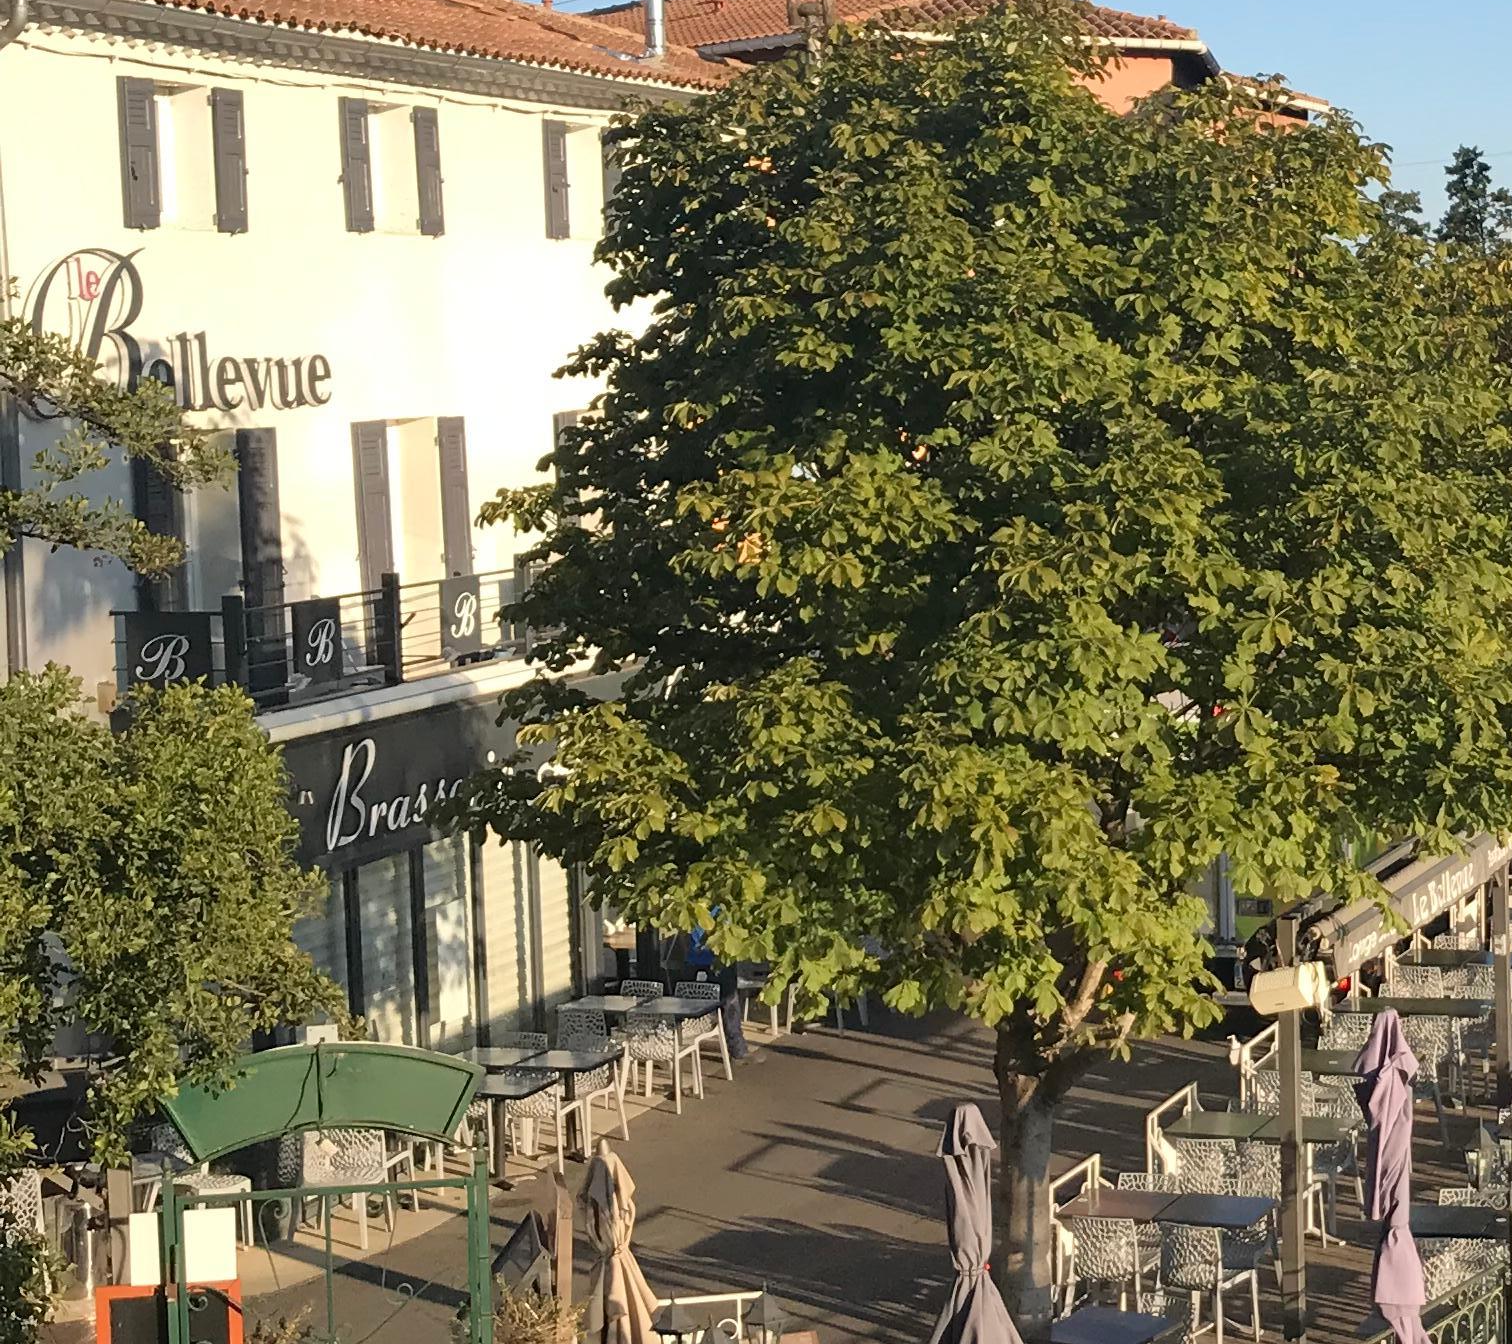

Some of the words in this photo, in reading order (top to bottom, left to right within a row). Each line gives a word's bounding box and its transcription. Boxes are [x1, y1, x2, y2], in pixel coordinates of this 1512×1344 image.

[451, 592, 477, 640] B
[135, 634, 190, 682] B
[306, 618, 337, 667] B
[326, 738, 514, 851] Brass
